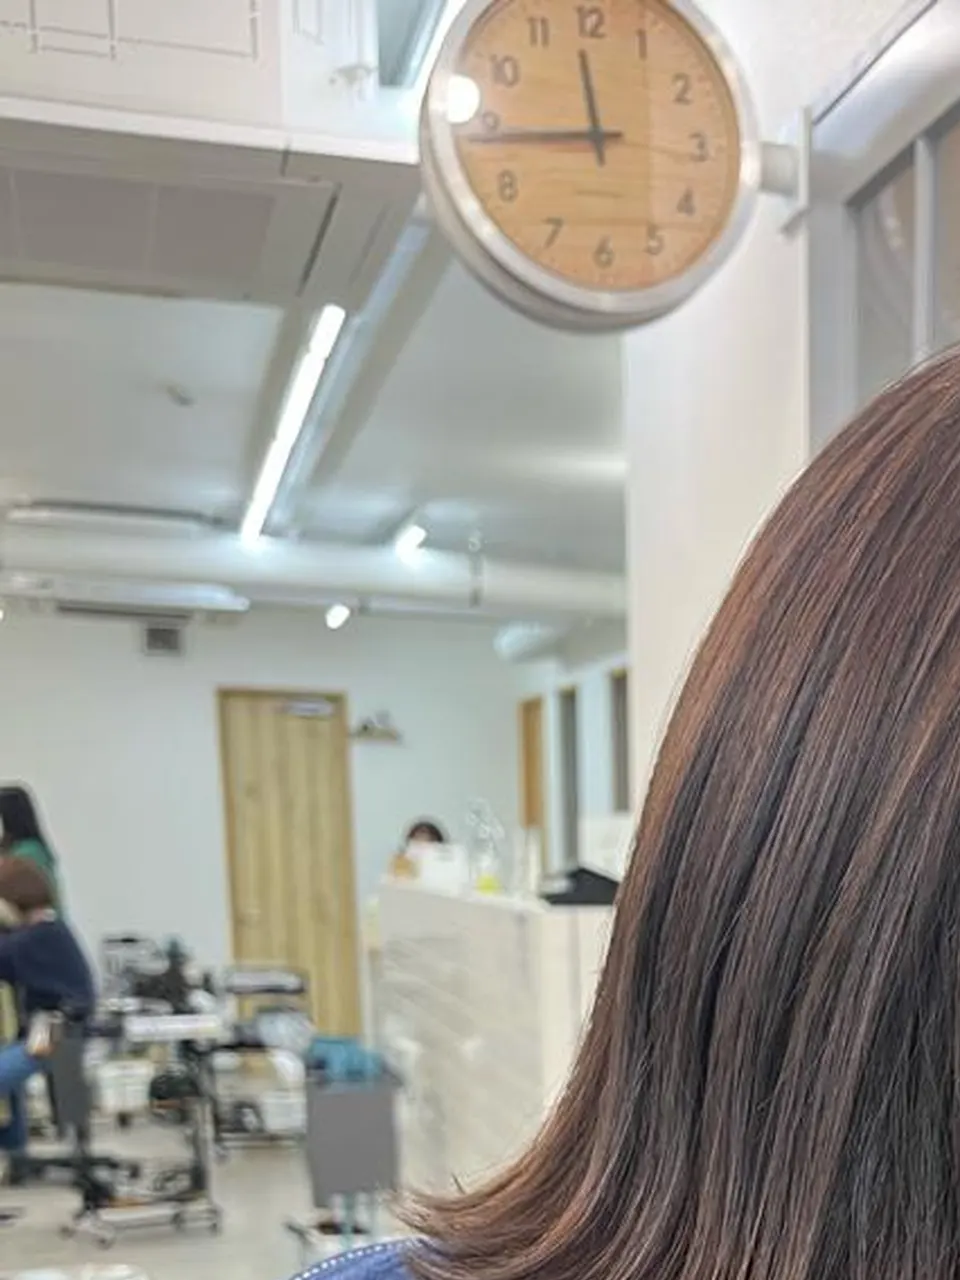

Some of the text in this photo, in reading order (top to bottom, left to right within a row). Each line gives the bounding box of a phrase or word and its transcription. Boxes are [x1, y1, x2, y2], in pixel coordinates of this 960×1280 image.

[528, 17, 549, 47] 11
[577, 6, 606, 39] 12
[636, 28, 647, 60] 1
[491, 55, 519, 86] 10
[673, 74, 691, 104] 2
[689, 132, 708, 162] 3
[498, 170, 518, 202] 8
[676, 188, 695, 216] 4
[543, 217, 563, 247] 7
[645, 224, 665, 255] 5
[594, 238, 614, 268] 6
